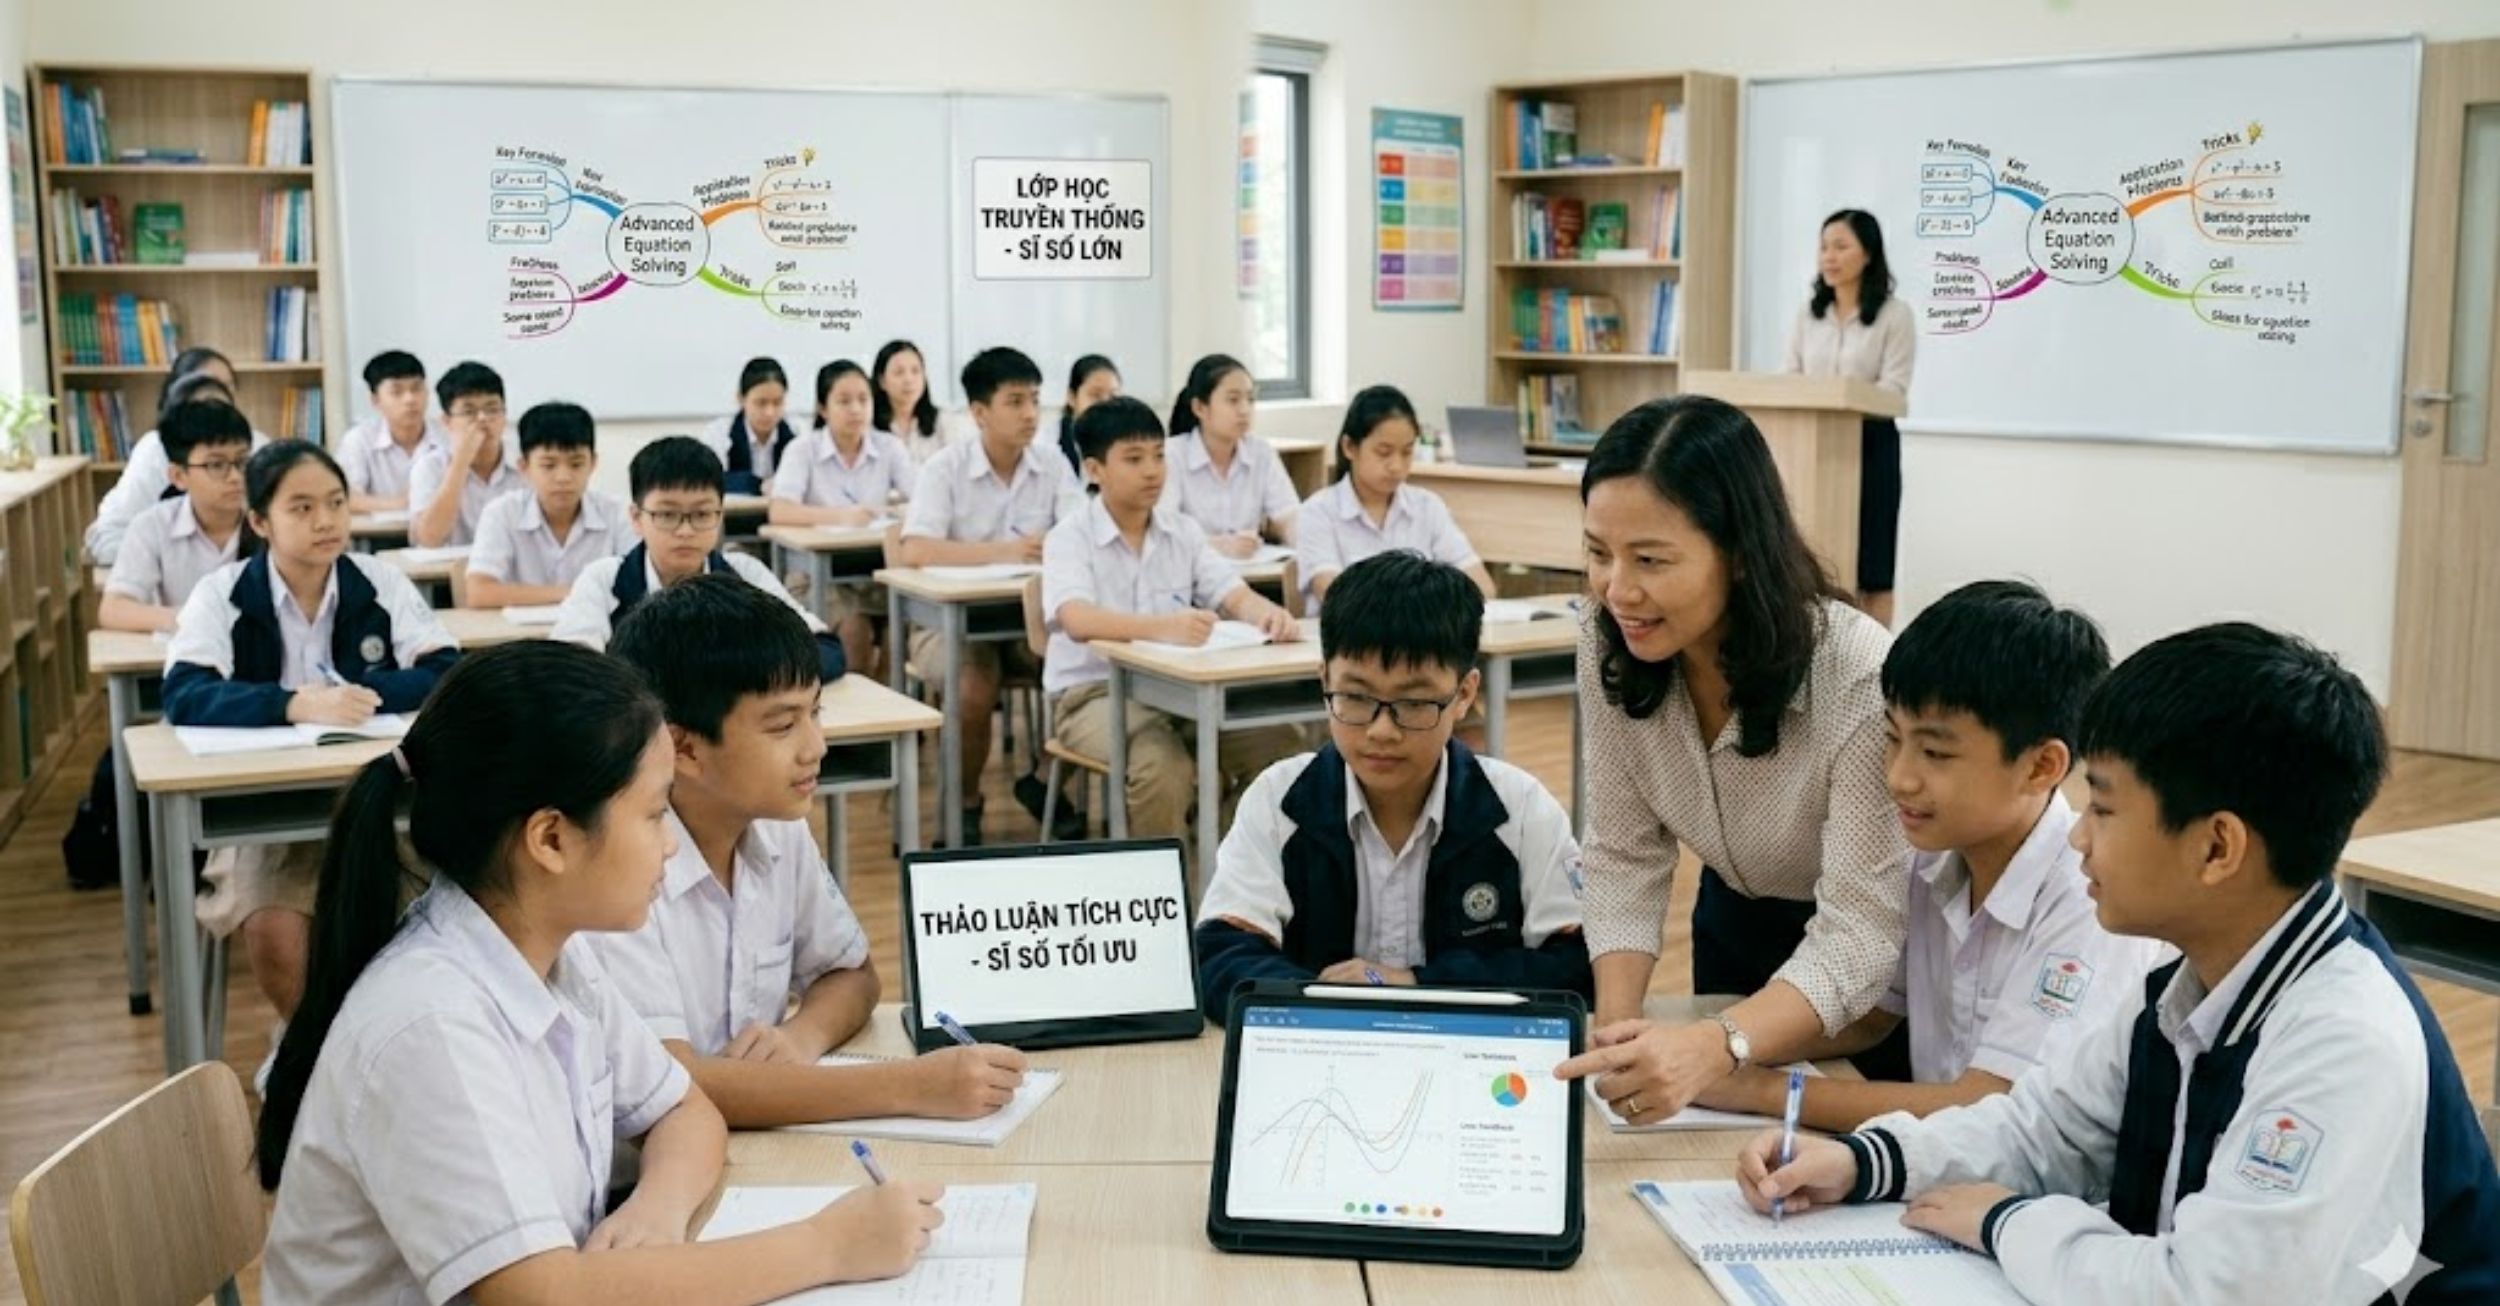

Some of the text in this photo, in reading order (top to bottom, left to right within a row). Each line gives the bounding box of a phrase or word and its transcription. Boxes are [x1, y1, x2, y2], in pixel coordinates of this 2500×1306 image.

[2202, 132, 2241, 150] Tricks
[1017, 173, 1110, 203] LỚP HỌC
[620, 215, 694, 231] Advanced
[981, 202, 1145, 229] TRUYỀN THỐNG
[2041, 207, 2119, 225] Advanced
[624, 236, 691, 255] Equation
[1081, 234, 1122, 260] LỚN
[2045, 230, 2115, 250] Equation
[631, 257, 686, 277] Solving
[2050, 252, 2108, 274] Solving
[921, 896, 1178, 936] THẢO LUẬN TÍCH CỰC
[1057, 933, 1096, 966] TỐI
[1104, 938, 1136, 963] ƯU
